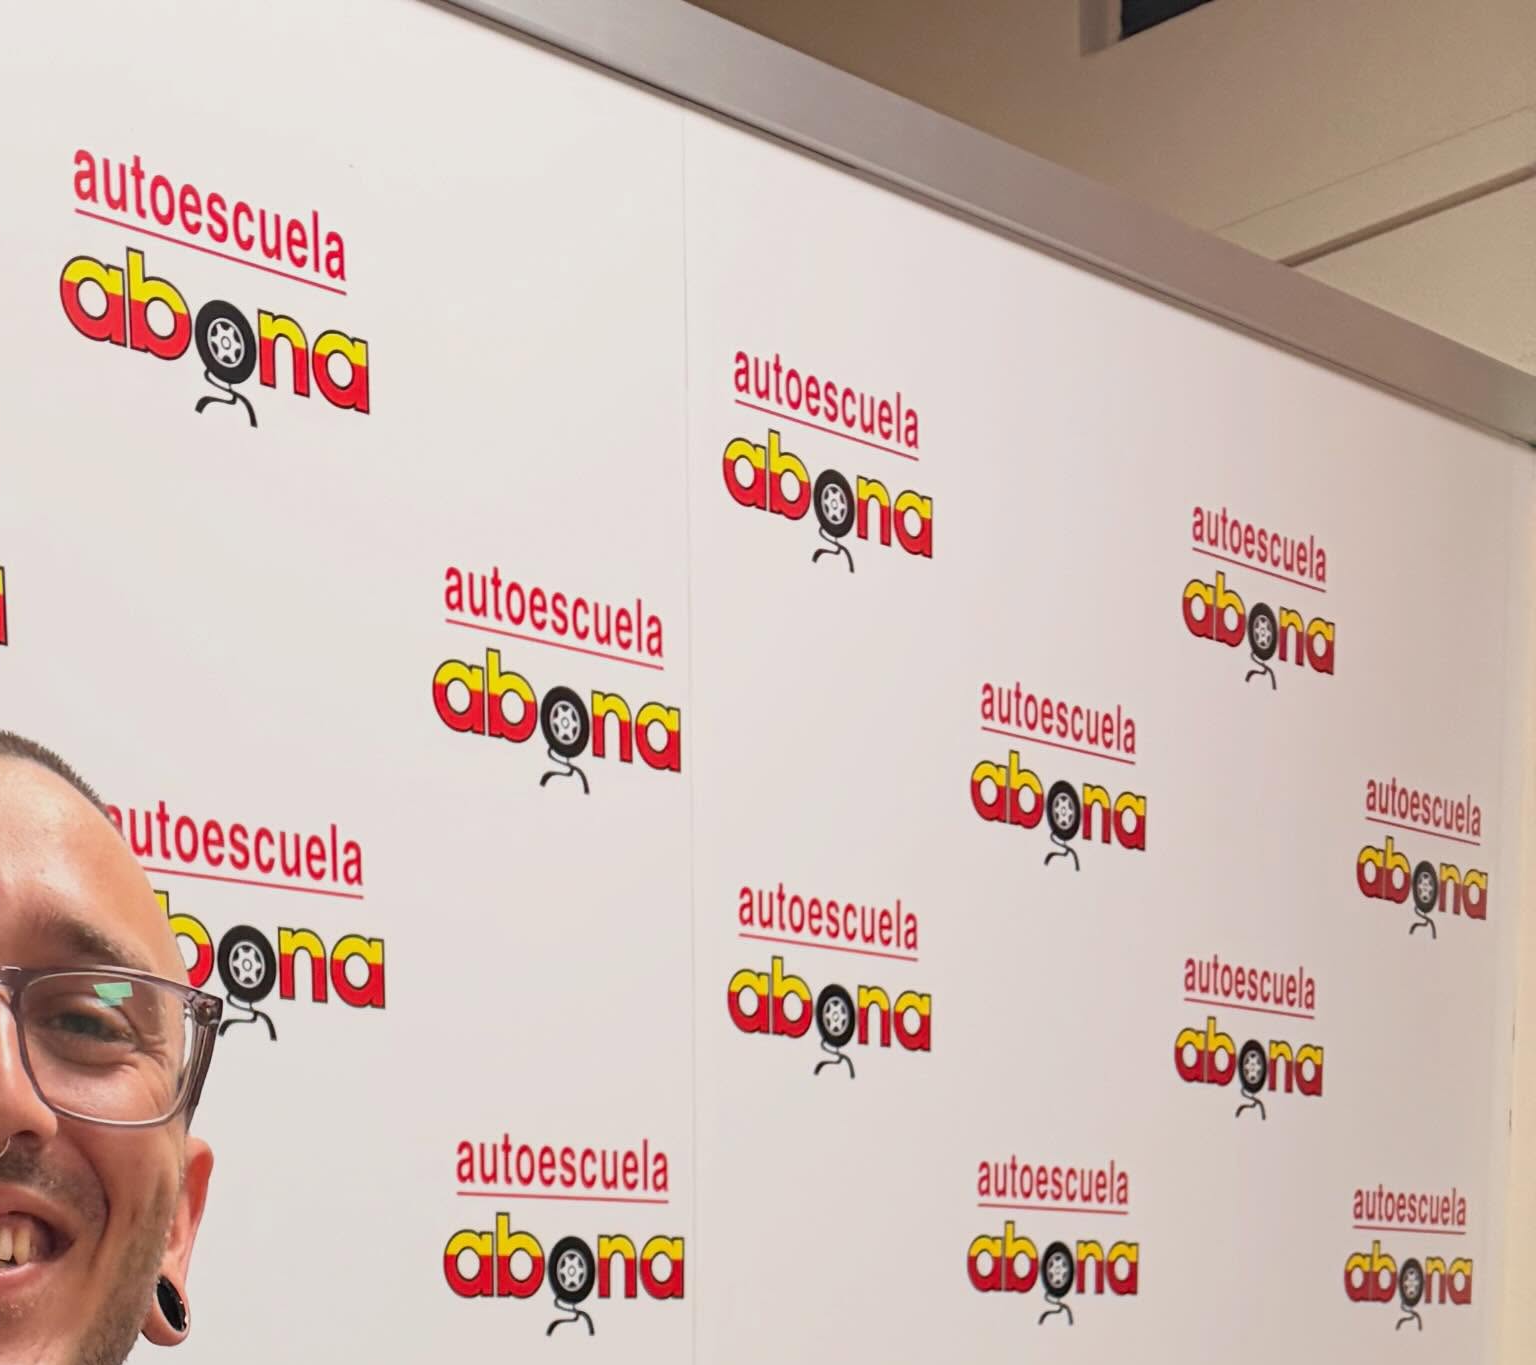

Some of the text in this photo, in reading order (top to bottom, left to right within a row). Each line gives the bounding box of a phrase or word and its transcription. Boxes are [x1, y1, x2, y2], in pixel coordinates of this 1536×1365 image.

[72, 148, 347, 282] autoescuela
[58, 246, 371, 415] abona
[733, 351, 920, 450] autoescuela
[721, 428, 934, 560] abona
[1192, 505, 1327, 584] autoescuela
[444, 565, 664, 659] autoescuela
[1181, 570, 1336, 676] abona
[431, 647, 683, 774] abona
[980, 681, 1137, 755] autoescuela
[970, 749, 1147, 852] abona
[1365, 777, 1481, 837] autoescuela
[739, 882, 919, 951] autoescuela
[1356, 835, 1488, 920] abona
[153, 889, 386, 1010] bona
[1184, 953, 1316, 1010] autoescuela
[727, 955, 933, 1053] abona
[1174, 1016, 1324, 1097] abona
[456, 1133, 669, 1192] autoescuela
[977, 1154, 1129, 1205] autoescuela
[1353, 1184, 1467, 1227] autoescuela
[443, 1212, 686, 1303] abona
[967, 1219, 1140, 1298] abona
[1344, 1240, 1473, 1307] abona
